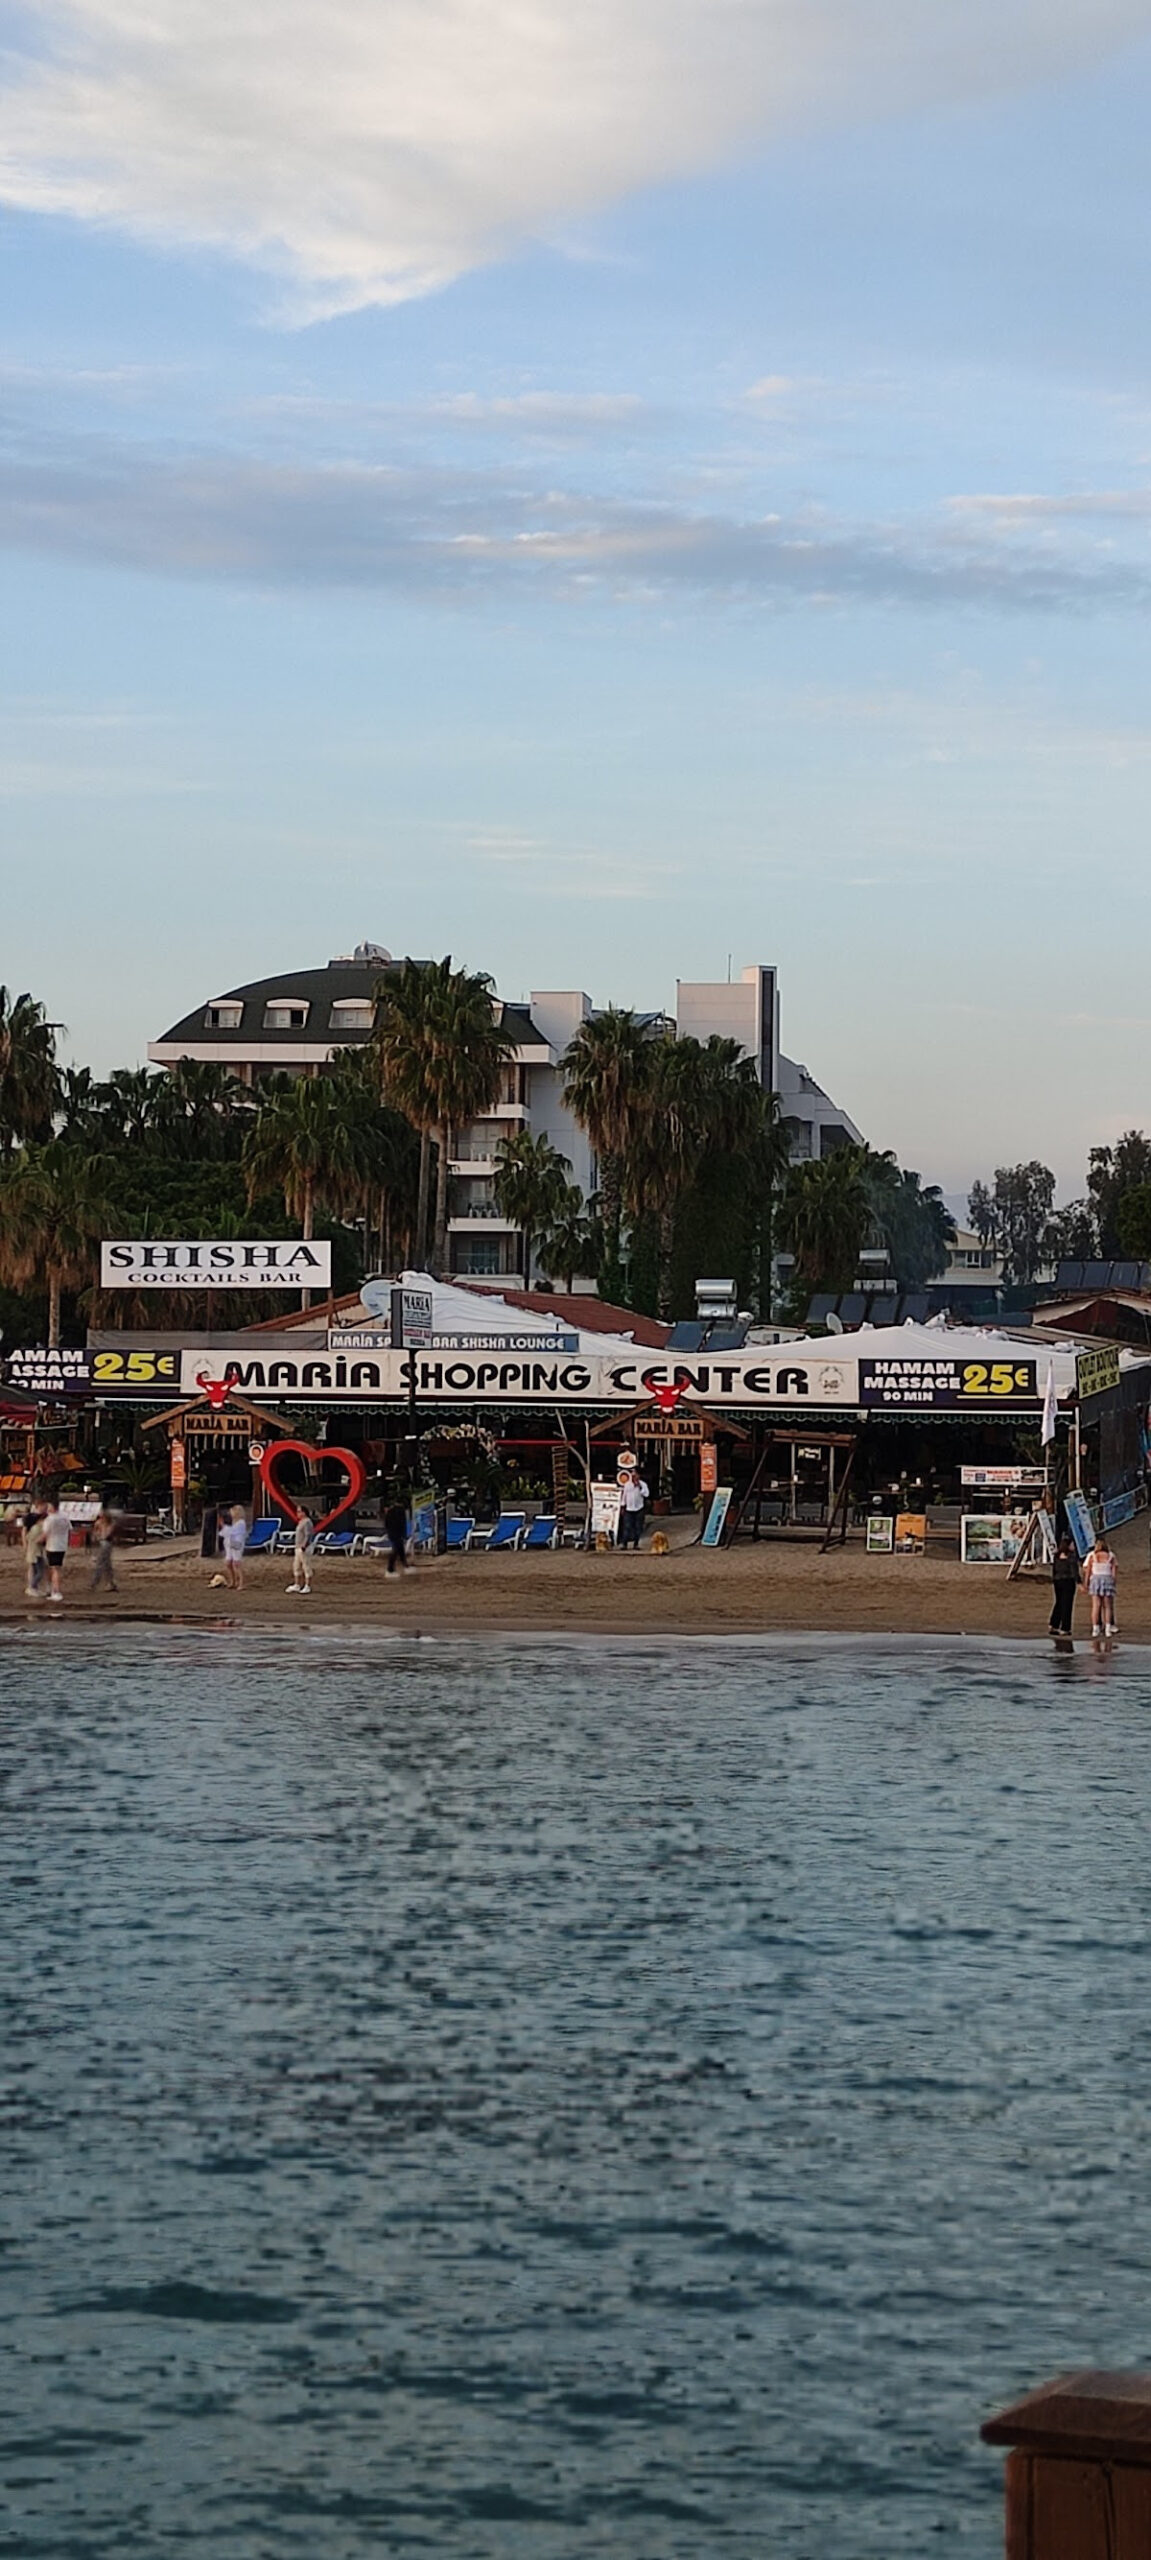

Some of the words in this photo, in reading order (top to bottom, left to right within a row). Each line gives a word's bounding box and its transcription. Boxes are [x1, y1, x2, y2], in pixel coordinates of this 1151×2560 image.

[109, 1245, 322, 1269] SHISHA
[128, 1271, 250, 1283] COCKTAILS
[259, 1272, 303, 1283] BAR
[460, 1337, 507, 1349] SHISHA
[509, 1337, 565, 1349] LOUNGE
[5, 1349, 84, 1362] AMAM
[93, 1352, 175, 1382] 25€
[874, 1361, 955, 1375] HAMAM
[399, 1360, 591, 1392] SHOPPING
[609, 1363, 809, 1395] CENTER
[863, 1375, 961, 1390] MASSAGE
[963, 1363, 1030, 1394] 25€
[31, 1379, 65, 1390] MIN
[882, 1391, 900, 1402] 90
[903, 1391, 933, 1402] MIN
[227, 1418, 249, 1431] BAR
[678, 1422, 702, 1435] BAR
